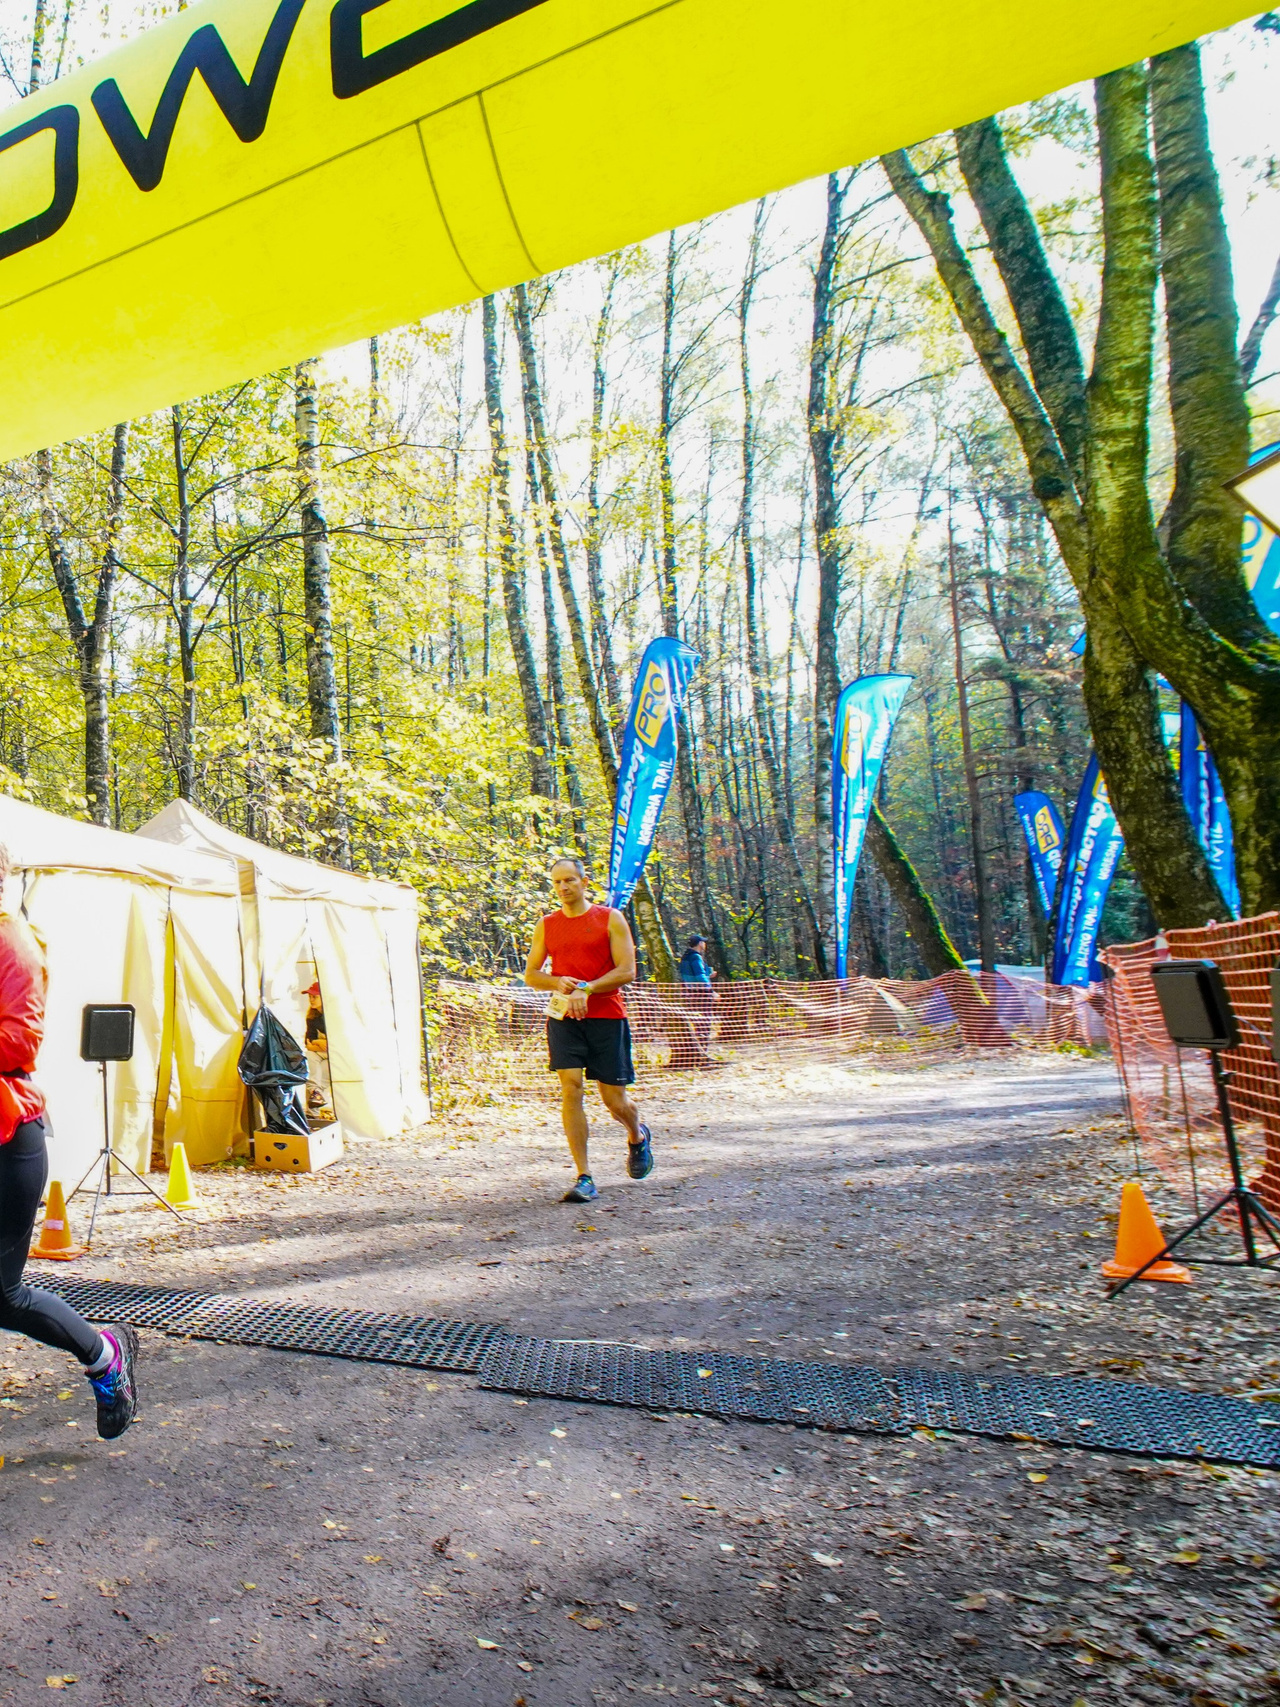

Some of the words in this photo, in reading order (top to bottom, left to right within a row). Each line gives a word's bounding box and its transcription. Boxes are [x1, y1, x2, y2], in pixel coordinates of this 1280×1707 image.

[638, 671, 666, 740] PRO
[636, 793, 664, 846] UGRESHA
[651, 757, 674, 790] TRAIL
[1082, 904, 1098, 932] TRAIL
